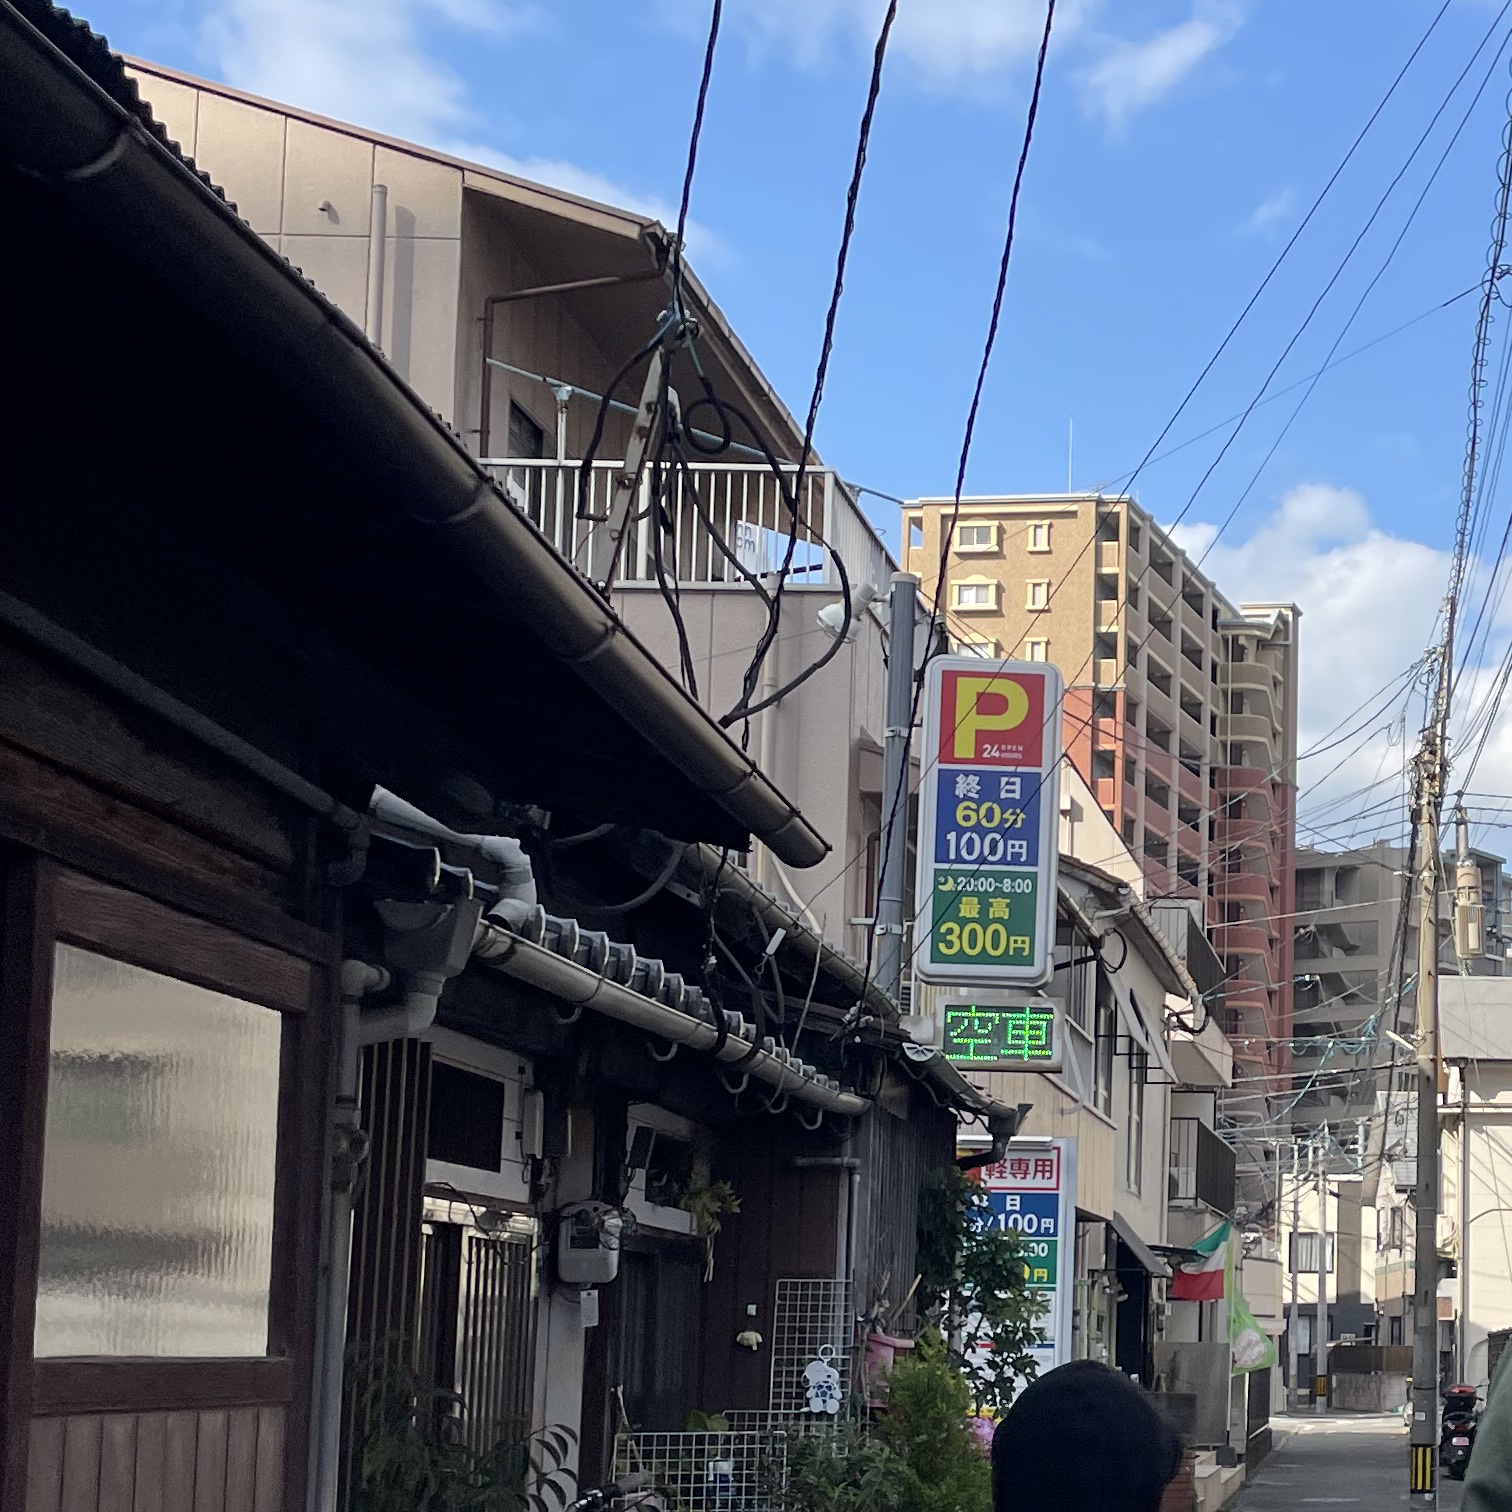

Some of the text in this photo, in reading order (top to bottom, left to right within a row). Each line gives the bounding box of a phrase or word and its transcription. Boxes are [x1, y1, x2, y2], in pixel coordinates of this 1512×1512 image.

[953, 676, 1030, 759] P
[982, 743, 1024, 758] 24 OPEN
[955, 773, 1022, 800] 終日
[955, 800, 1027, 829] 60分
[946, 831, 1028, 862] 100円
[958, 896, 1011, 920] 最高
[937, 921, 1031, 957] 300円
[945, 1005, 1055, 1062] 空車
[984, 1158, 1054, 1181] 軽専用
